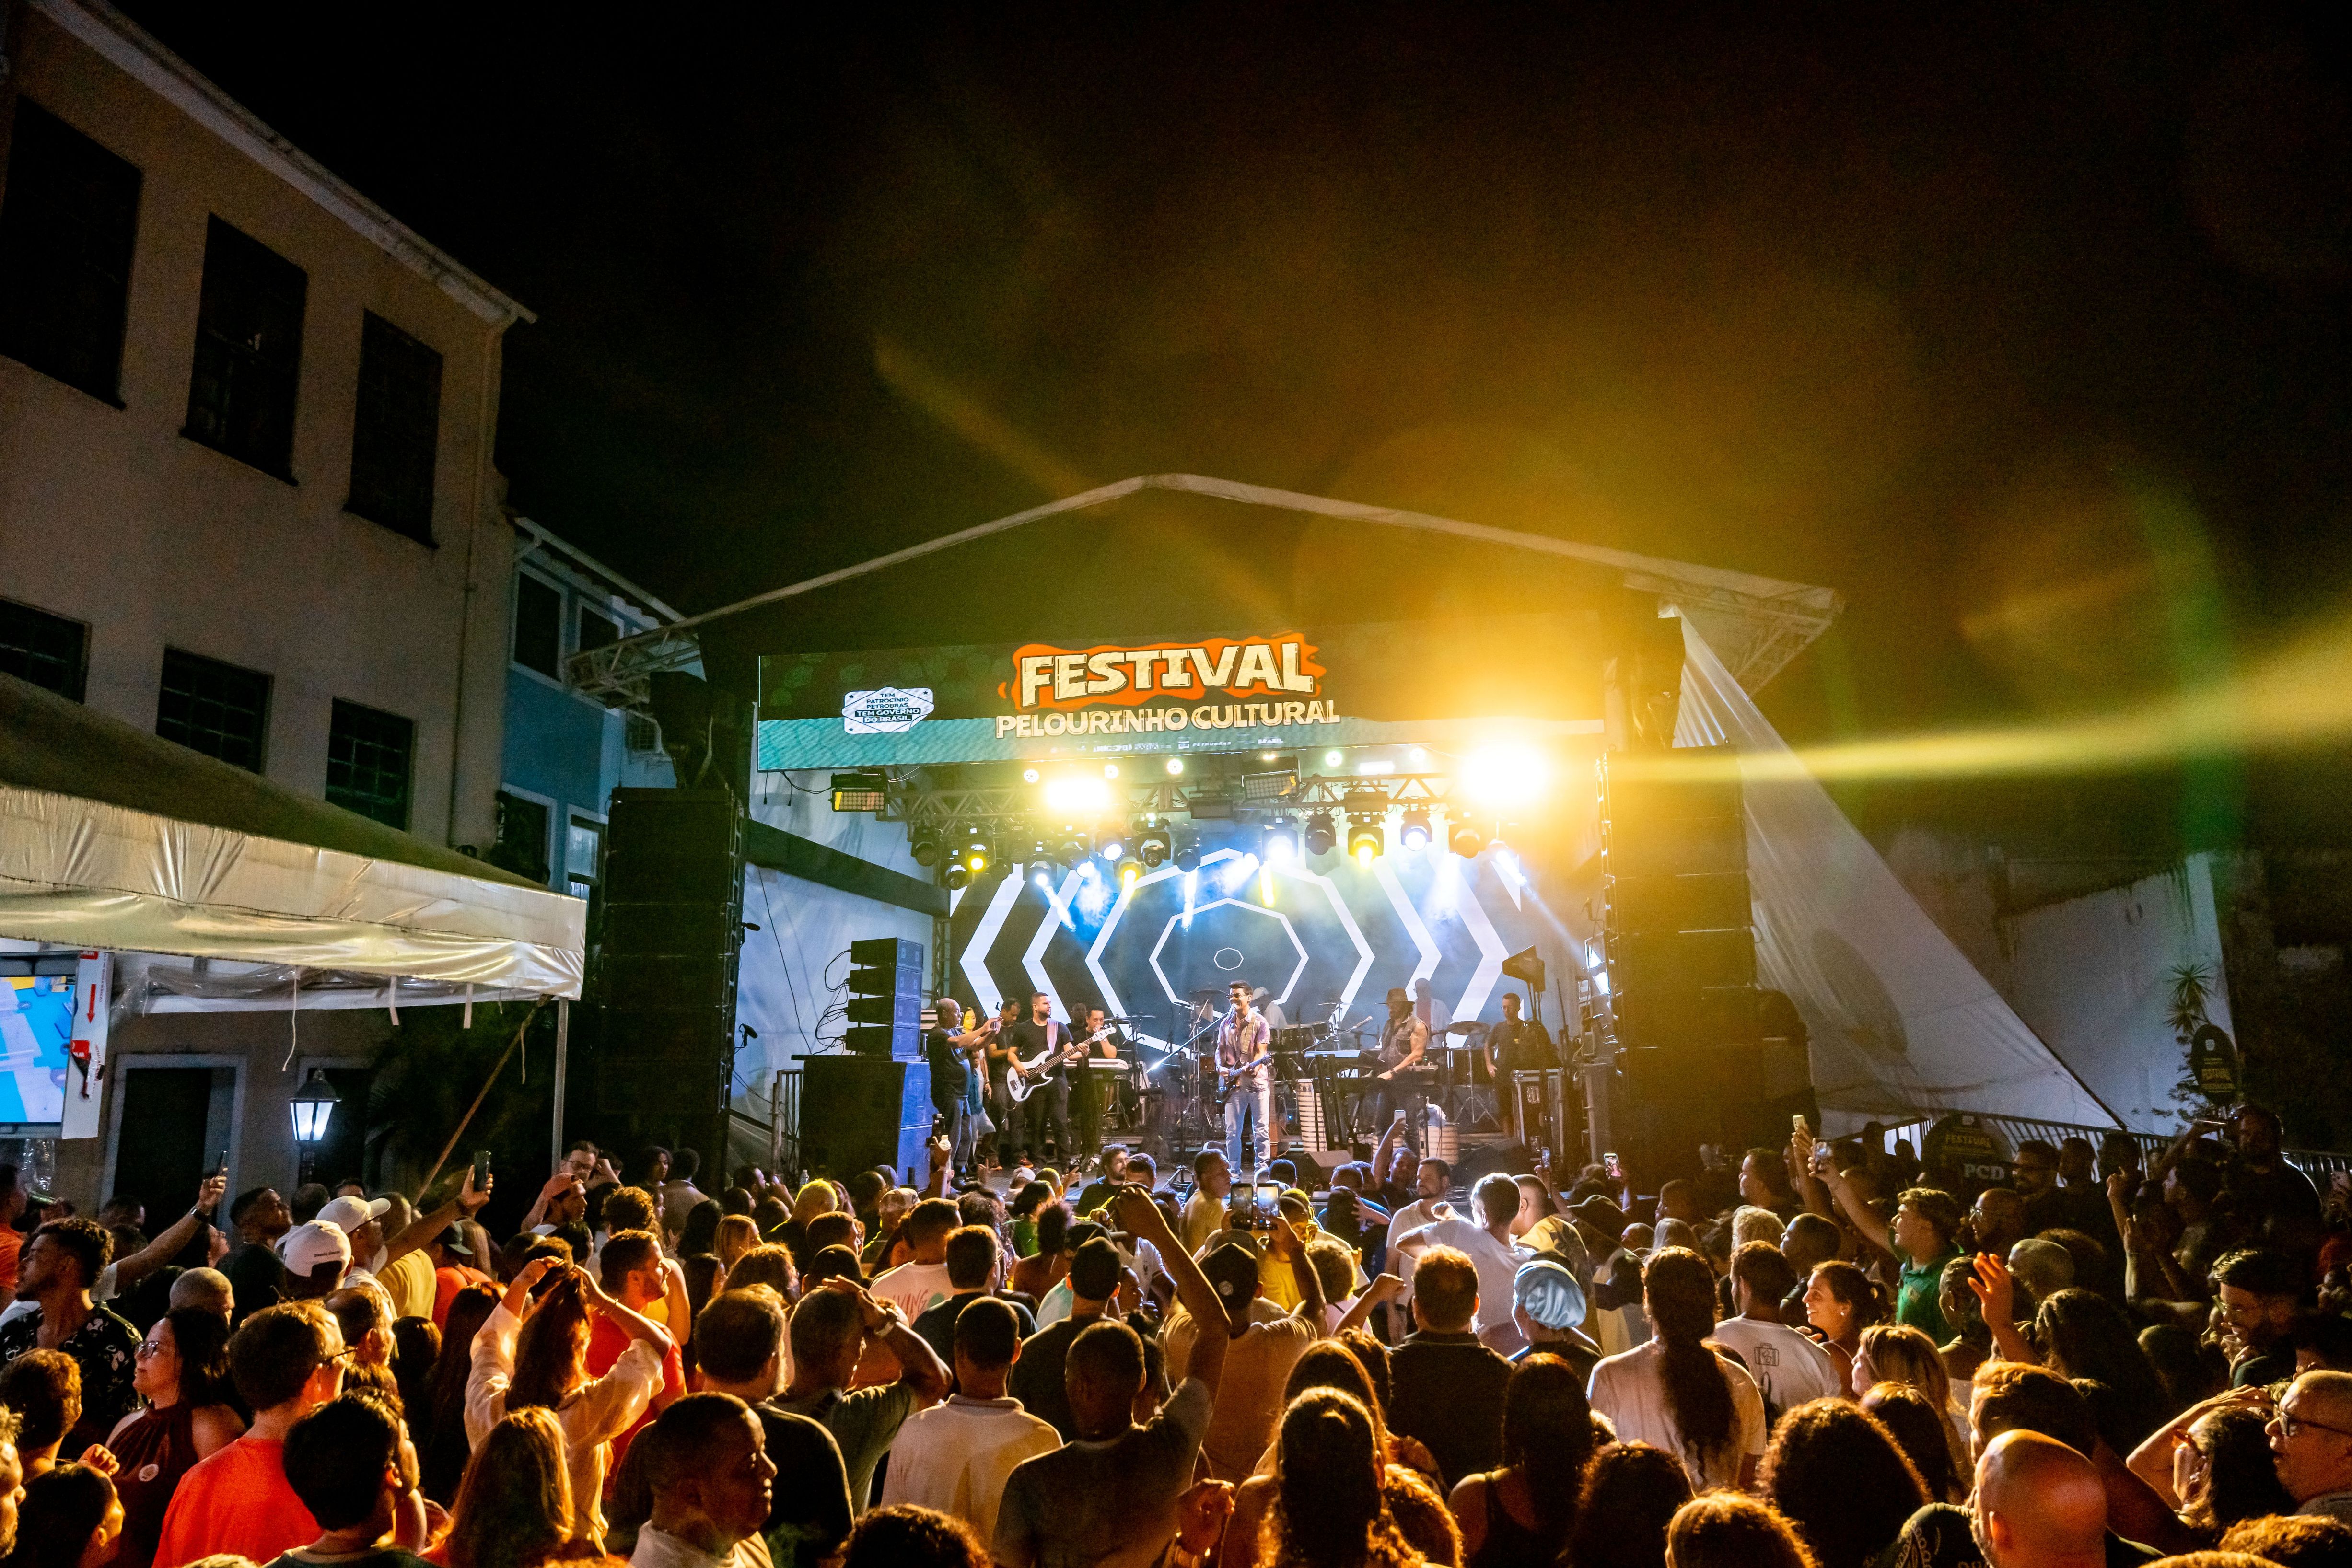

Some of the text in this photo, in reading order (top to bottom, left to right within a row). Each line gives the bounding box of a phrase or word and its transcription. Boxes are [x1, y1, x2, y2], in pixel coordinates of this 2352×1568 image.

[1022, 643, 1314, 707] FESTIVAL
[996, 700, 1340, 738] PELOURINHO CULTURAL
[1963, 1163, 2004, 1180] PCD
